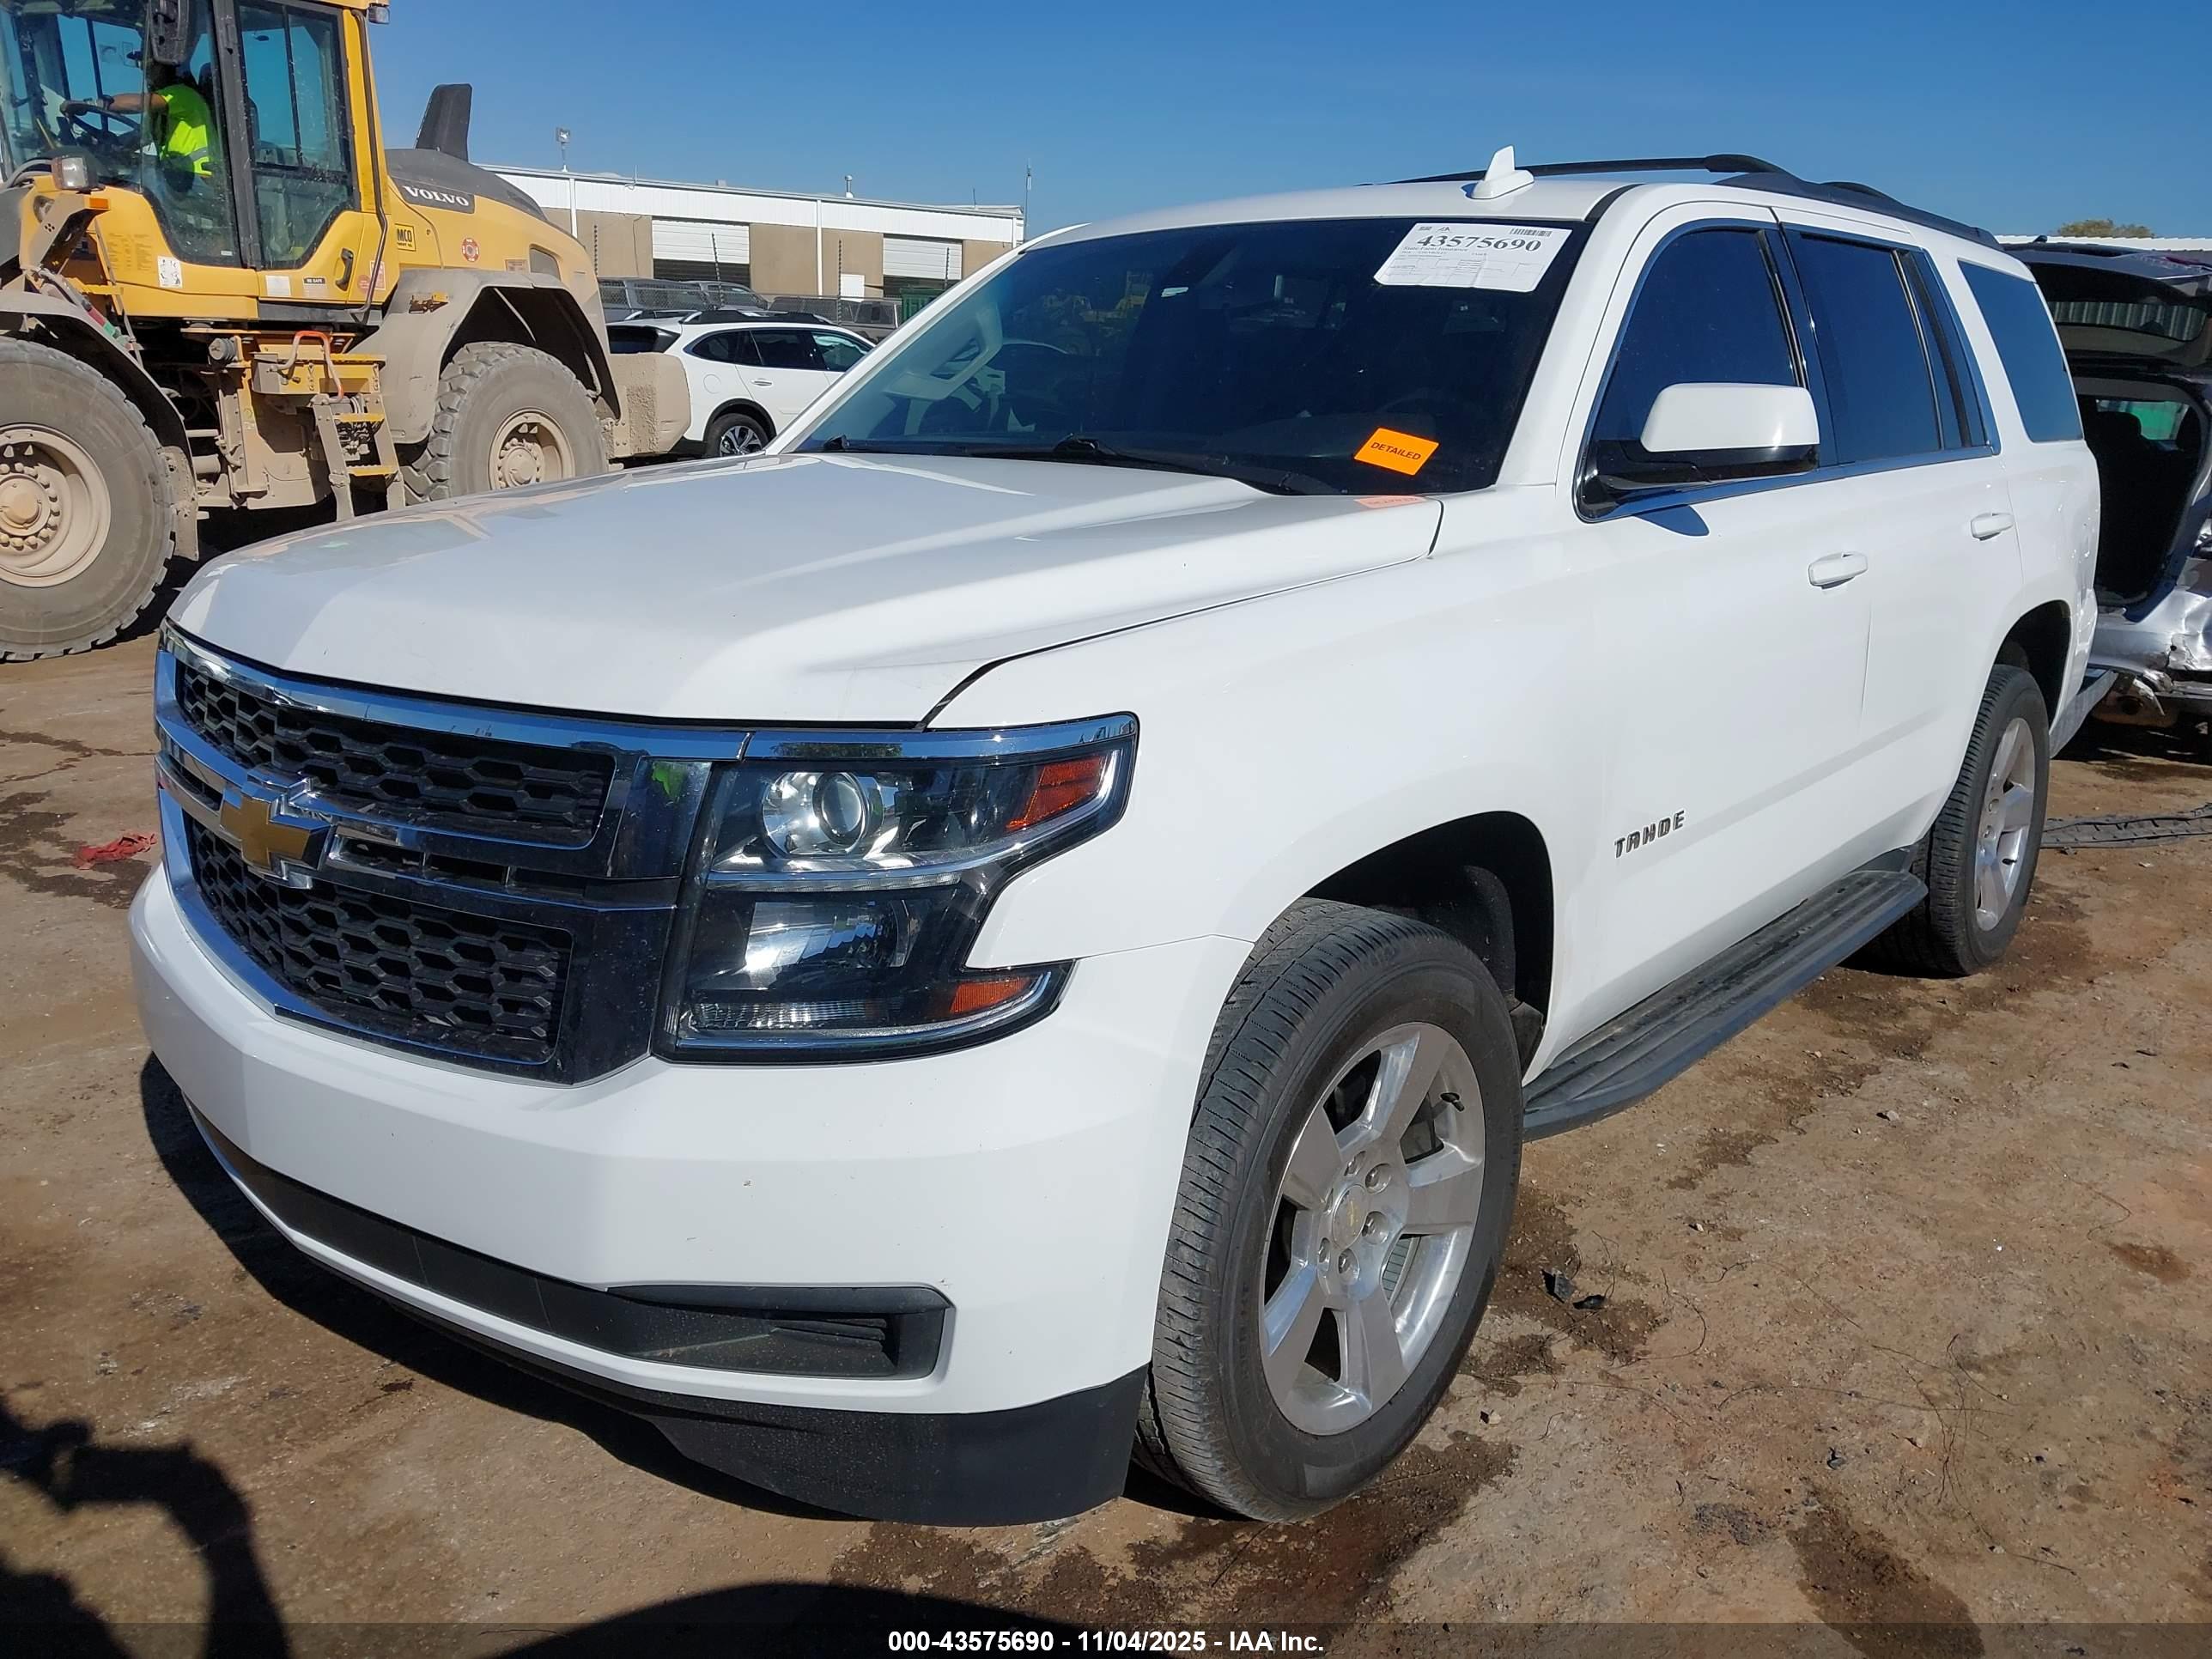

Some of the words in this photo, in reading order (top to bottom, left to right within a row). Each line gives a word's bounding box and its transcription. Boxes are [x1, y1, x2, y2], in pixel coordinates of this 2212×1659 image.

[403, 185, 469, 206] VOLVO
[396, 228, 413, 242] MCO
[1417, 234, 1542, 252] 43575690
[1370, 441, 1422, 460] DETAILED
[1613, 810, 1685, 859] TAHOE
